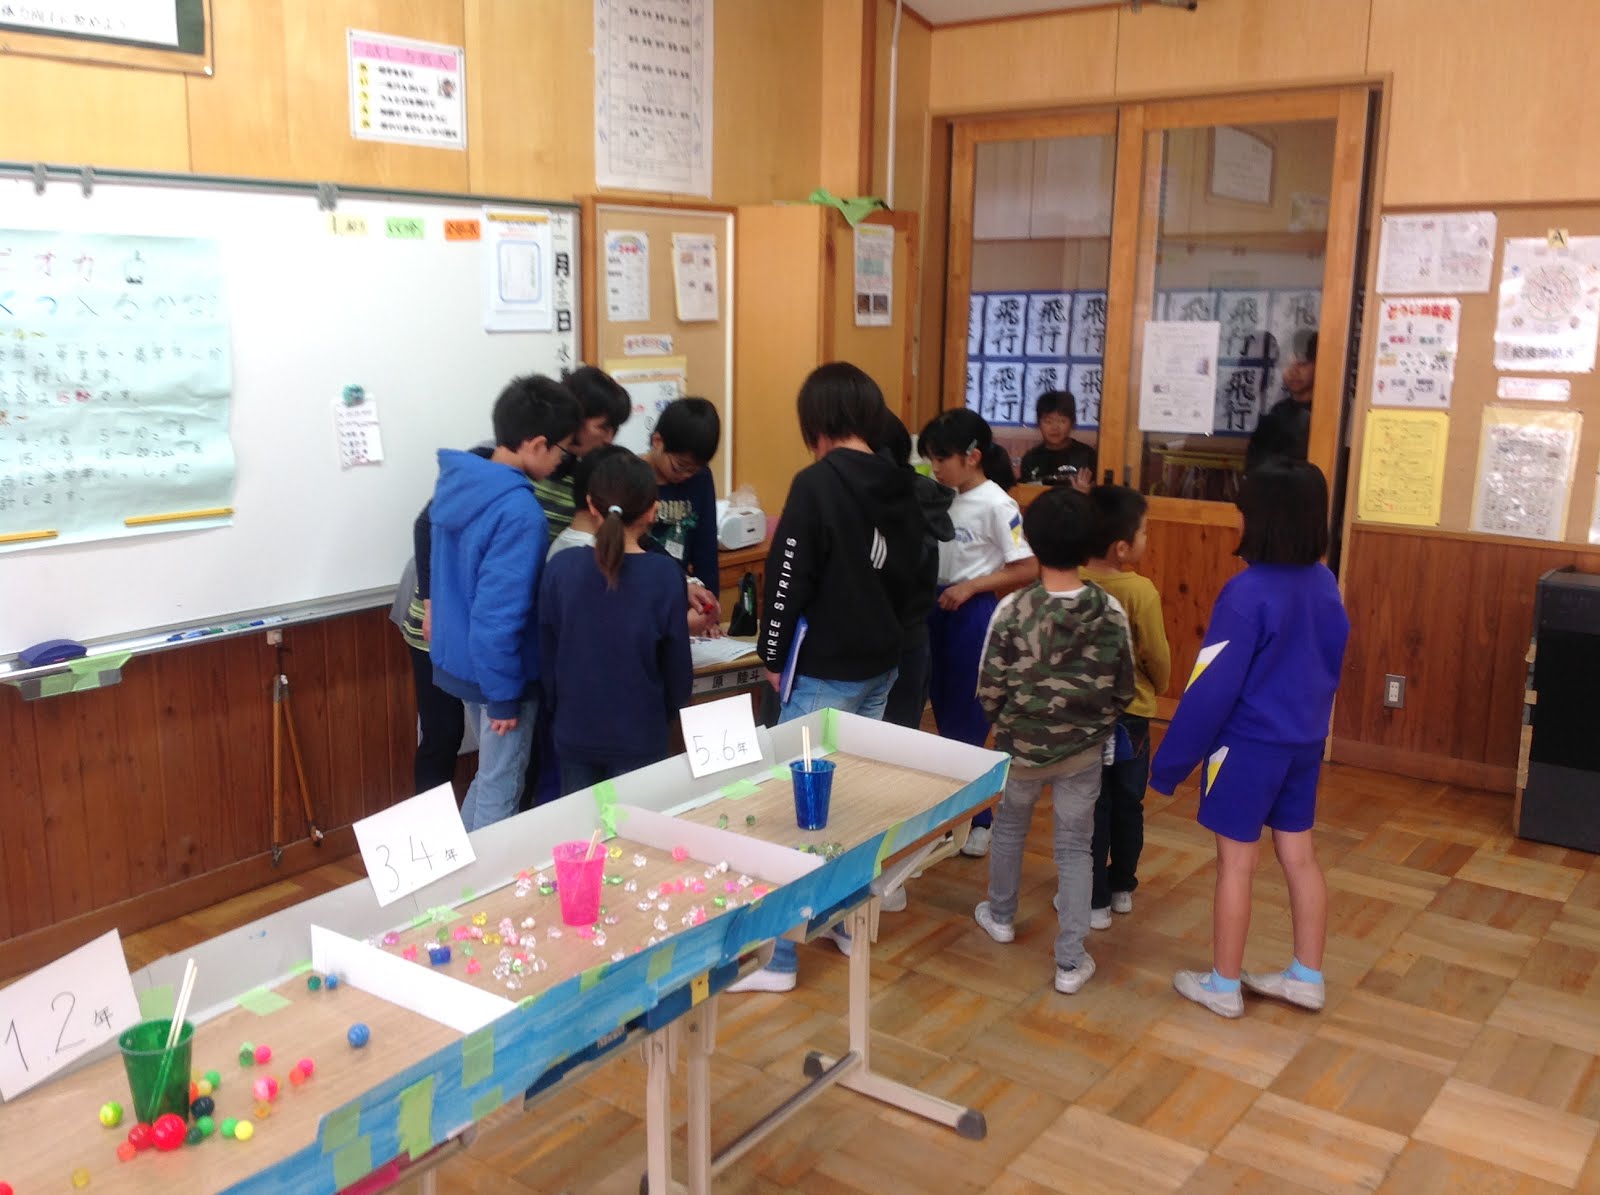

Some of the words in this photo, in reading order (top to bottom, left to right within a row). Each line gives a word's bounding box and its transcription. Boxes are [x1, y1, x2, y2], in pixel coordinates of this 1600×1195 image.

[993, 299, 1020, 353] 飛行
[1035, 298, 1067, 353] 飛行
[986, 366, 1019, 421] 飛行
[1225, 369, 1257, 430] 飛行
[773, 537, 798, 611] STRIPES
[766, 619, 782, 662] THREE
